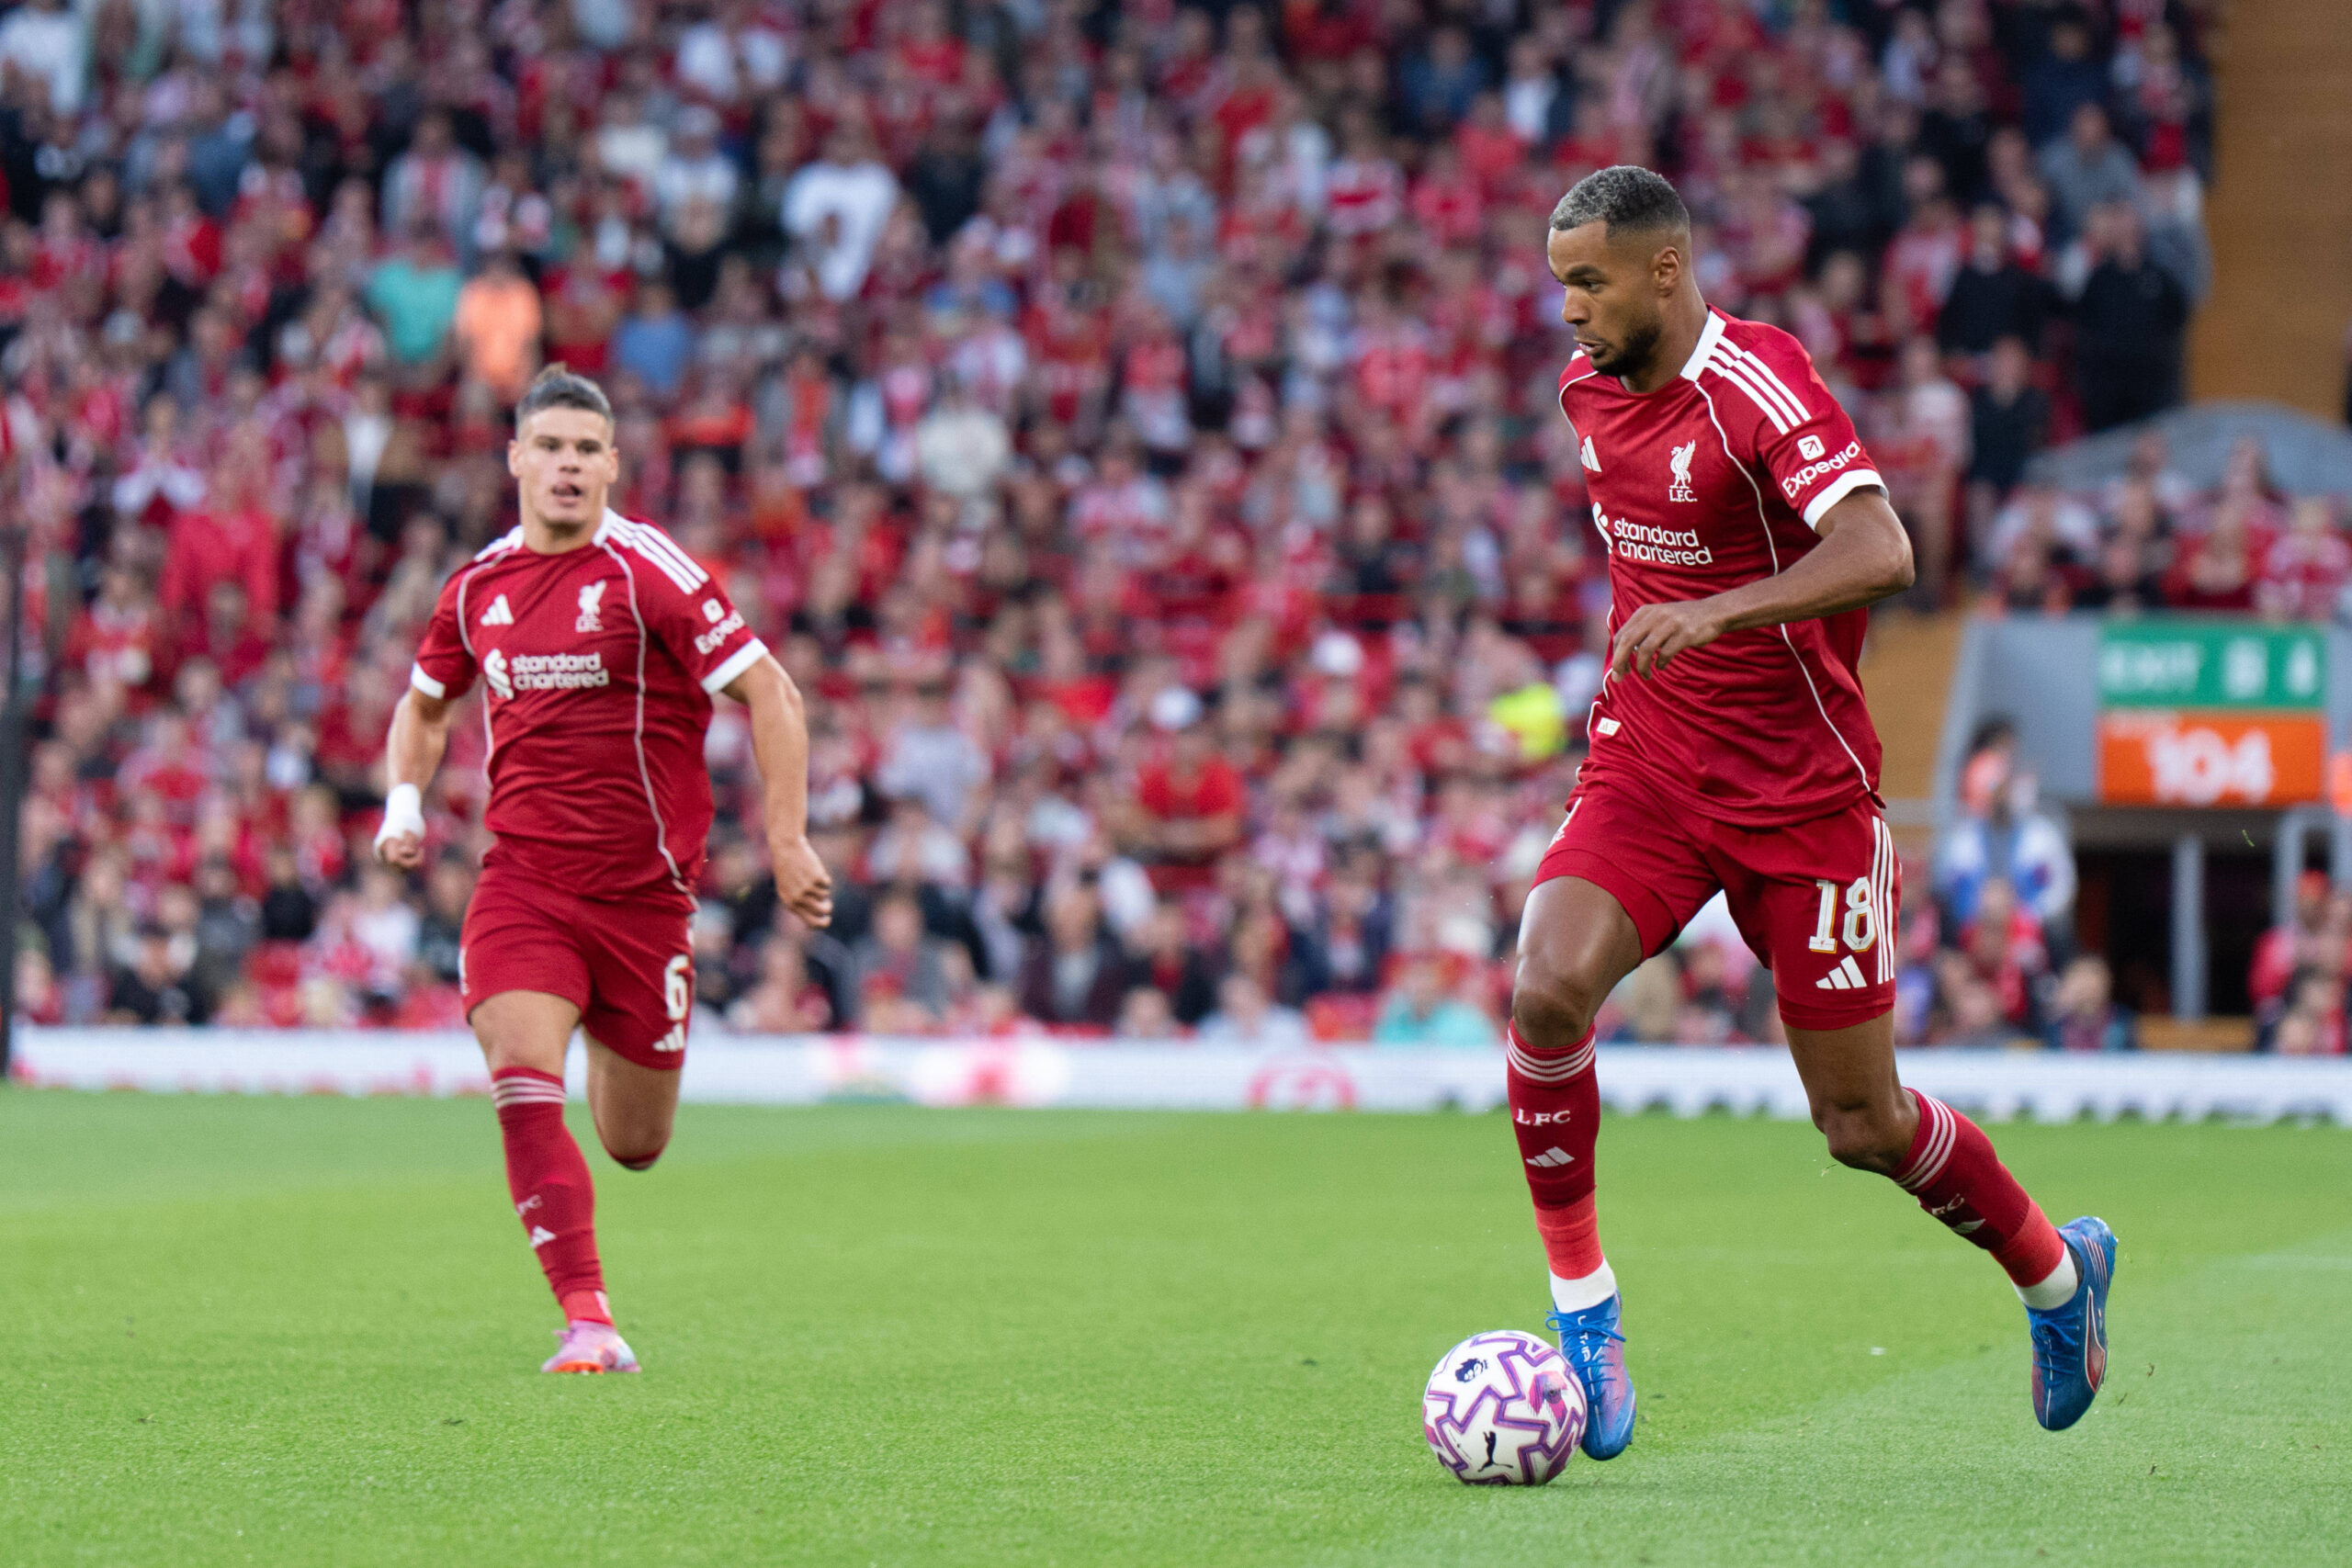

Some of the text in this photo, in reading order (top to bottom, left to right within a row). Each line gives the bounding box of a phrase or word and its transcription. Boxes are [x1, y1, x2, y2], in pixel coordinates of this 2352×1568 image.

[1781, 441, 1860, 499] Expedia
[1613, 517, 1700, 547] standard
[1618, 539, 1713, 566] chartered
[511, 651, 601, 673] standard
[514, 668, 609, 691] chartered
[2148, 728, 2274, 805] 104
[1808, 874, 1877, 953] 18
[664, 954, 688, 1021] 6
[1515, 1108, 1571, 1126] LFC
[1917, 1193, 1964, 1214] FC
